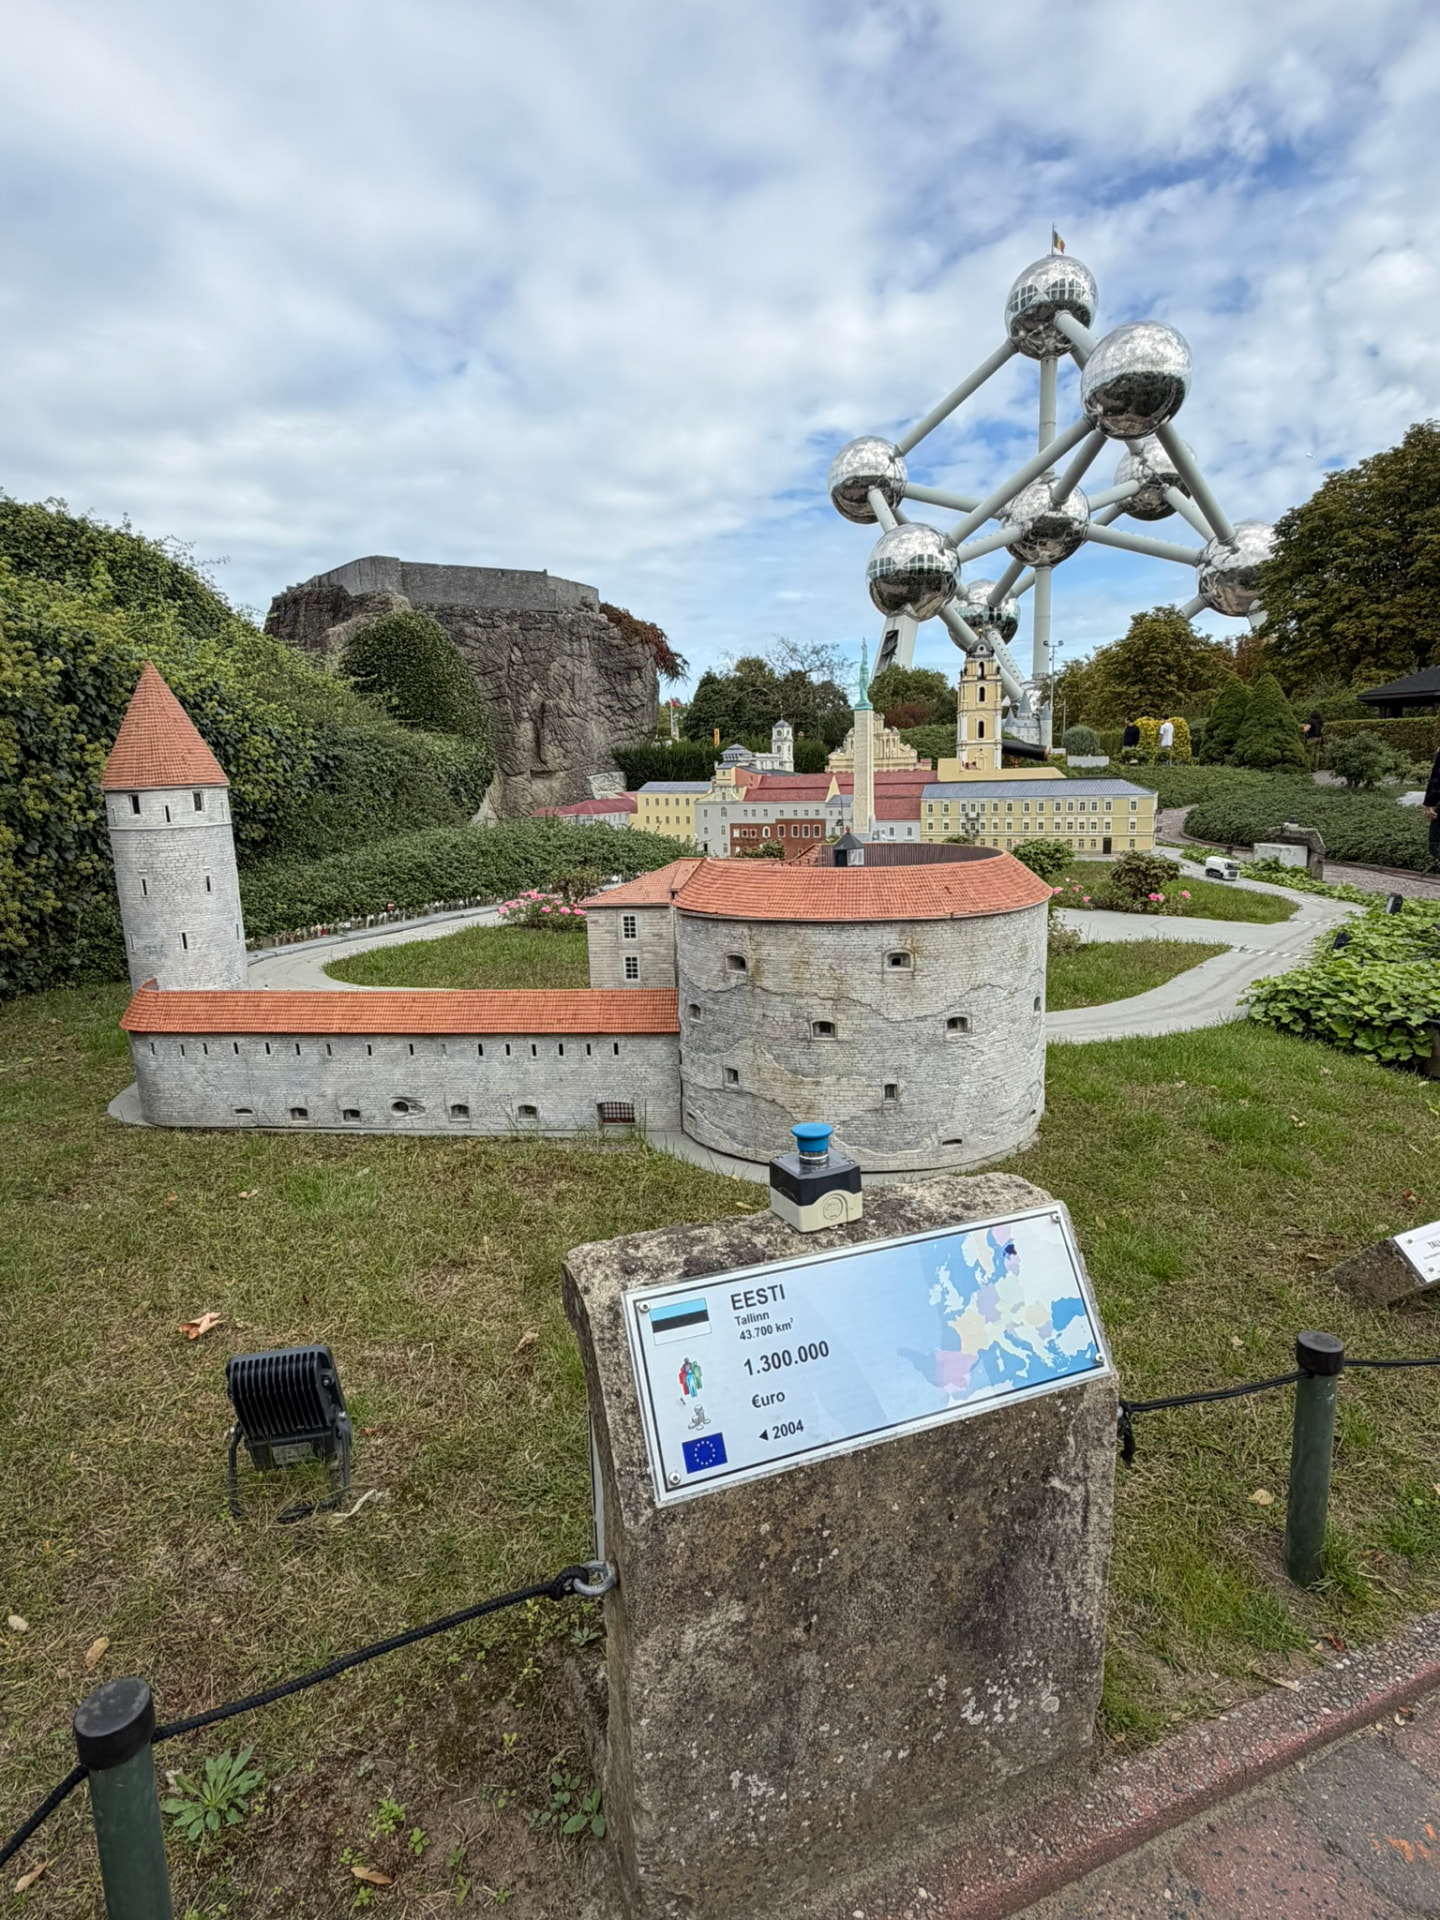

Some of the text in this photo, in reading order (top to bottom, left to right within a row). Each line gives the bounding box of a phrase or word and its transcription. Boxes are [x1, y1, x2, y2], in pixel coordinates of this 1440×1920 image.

[730, 1284, 785, 1311] EESTI
[734, 1311, 770, 1326] Tallinn
[739, 1324, 774, 1341] 43.700
[743, 1340, 829, 1376] 1.300.000
[751, 1391, 786, 1409] €uro
[772, 1418, 805, 1440] 2004
